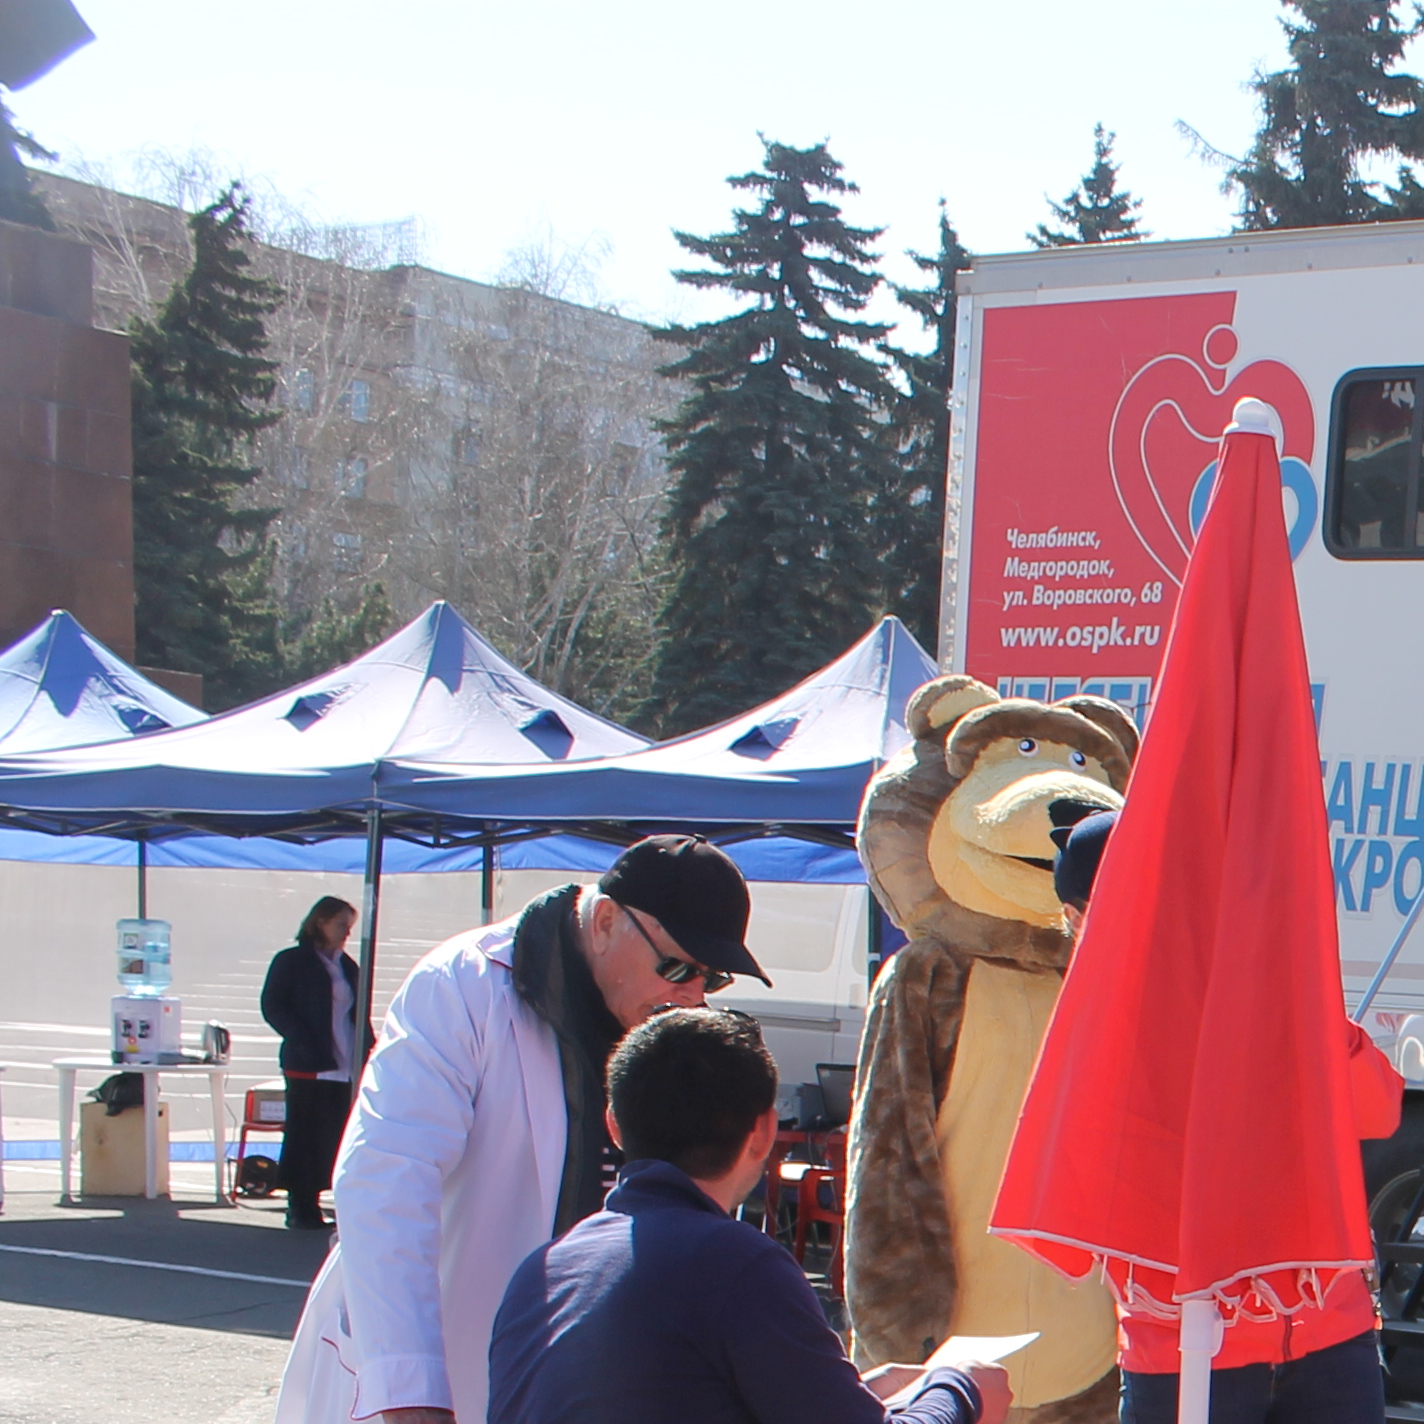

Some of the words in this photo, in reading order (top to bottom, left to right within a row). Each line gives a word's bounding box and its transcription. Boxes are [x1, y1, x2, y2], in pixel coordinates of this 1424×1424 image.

[1006, 526, 1101, 550] Челябинск,
[1003, 556, 1115, 581] Медгородок,
[1002, 590, 1028, 611] ул.
[1032, 584, 1137, 610] Воровского,
[1140, 581, 1163, 604] 68
[1000, 616, 1161, 654] www.ospk.ru
